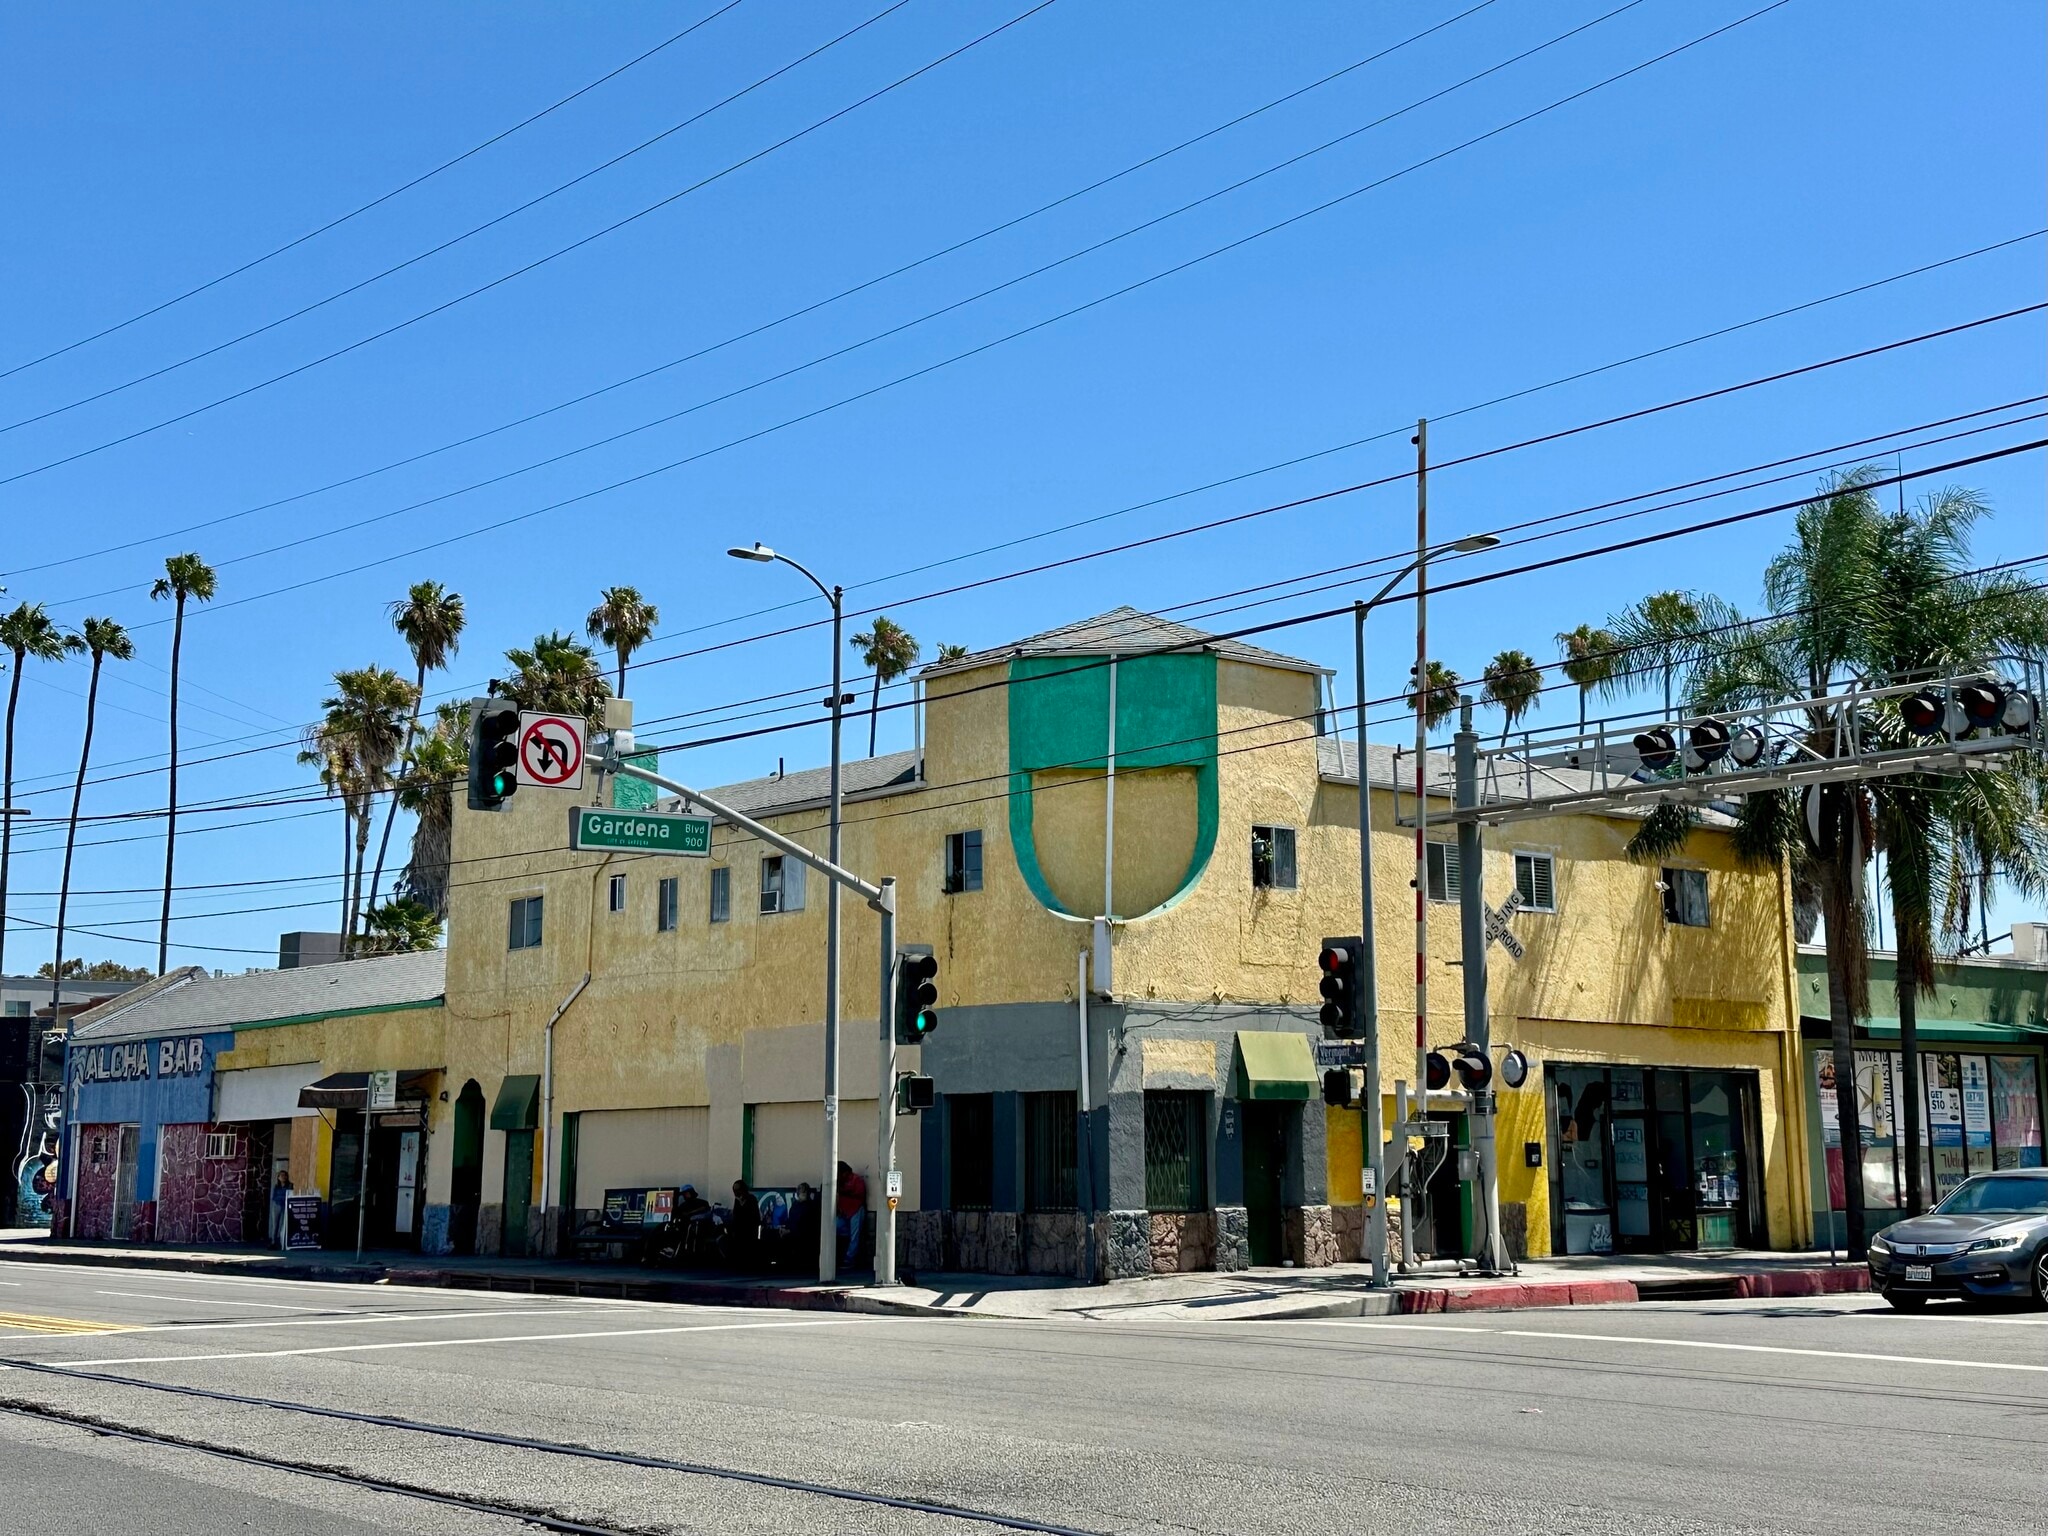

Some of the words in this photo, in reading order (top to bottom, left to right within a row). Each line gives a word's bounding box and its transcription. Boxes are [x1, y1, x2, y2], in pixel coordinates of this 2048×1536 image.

[588, 815, 670, 838] Gardena
[685, 823, 705, 834] Blvd
[685, 837, 703, 847] 900
[1499, 929, 1522, 957] ROAD
[158, 1038, 203, 1075] BAR
[1319, 1046, 1350, 1057] Vermont
[1930, 1090, 1943, 1099] GET
